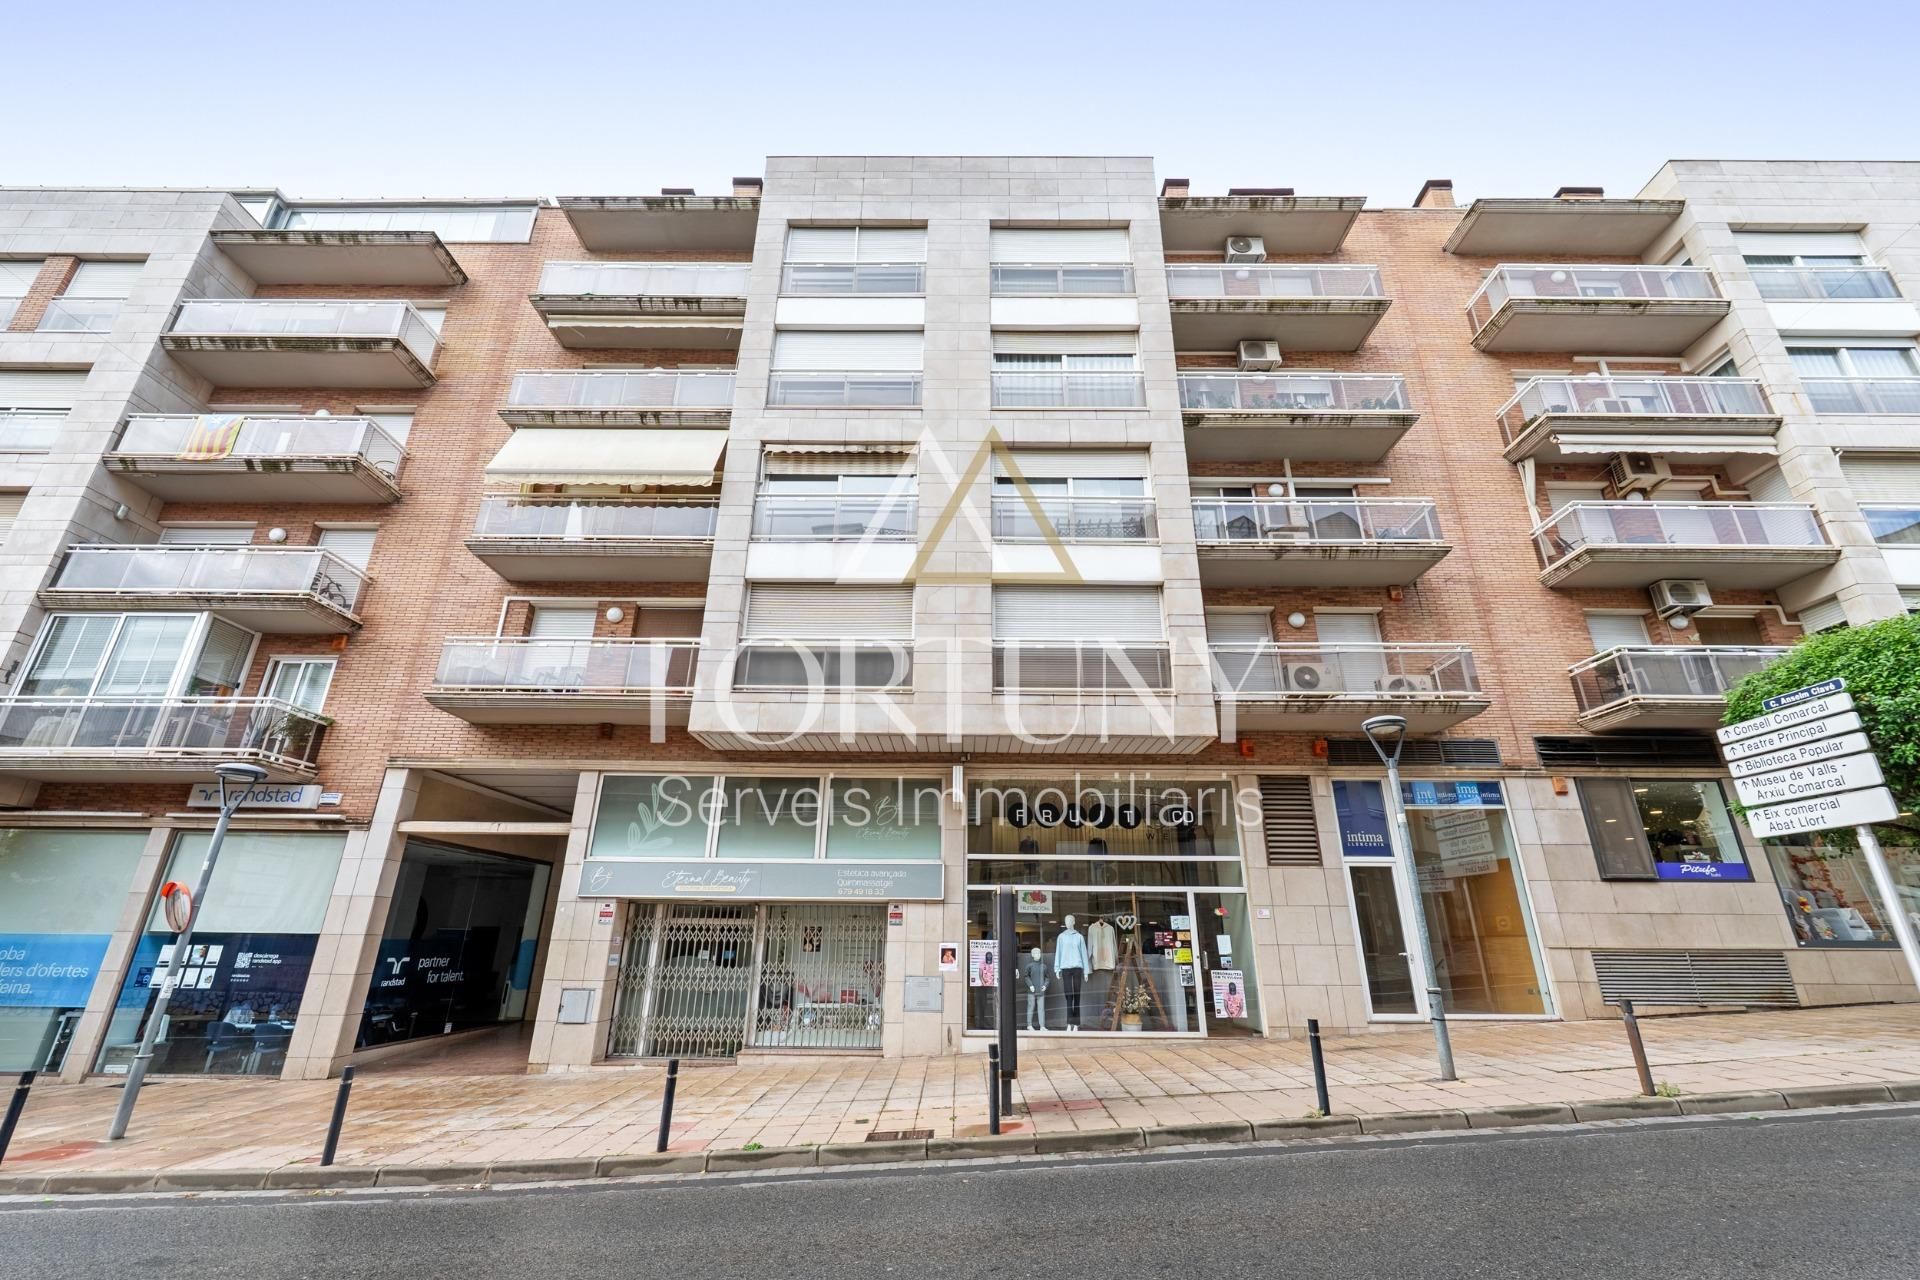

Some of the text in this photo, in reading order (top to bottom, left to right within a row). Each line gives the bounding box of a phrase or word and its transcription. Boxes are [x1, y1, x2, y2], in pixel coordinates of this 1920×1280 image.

[1769, 682, 1836, 708] C. Anselm Clavé
[1733, 701, 1829, 737] Consell Comarcal
[1739, 722, 1828, 753] Teatre Principal
[1744, 740, 1844, 772] Biblioteca Popular
[1751, 775, 1786, 789] Museu
[1789, 770, 1804, 781] de
[1809, 763, 1838, 777] Valls
[228, 786, 304, 802] randstad
[1756, 776, 1846, 800] Arxiu Comarcal
[1763, 798, 1841, 820] Eix comercial
[1769, 815, 1827, 832] Abat Llort
[1346, 831, 1383, 842] intima
[1680, 864, 1717, 876] Pitufo
[662, 868, 757, 893] Eternal Beauty
[26, 962, 89, 978] d'ofertes
[418, 956, 450, 971] partner
[381, 977, 406, 987] randstad
[427, 969, 464, 983] for talent.
